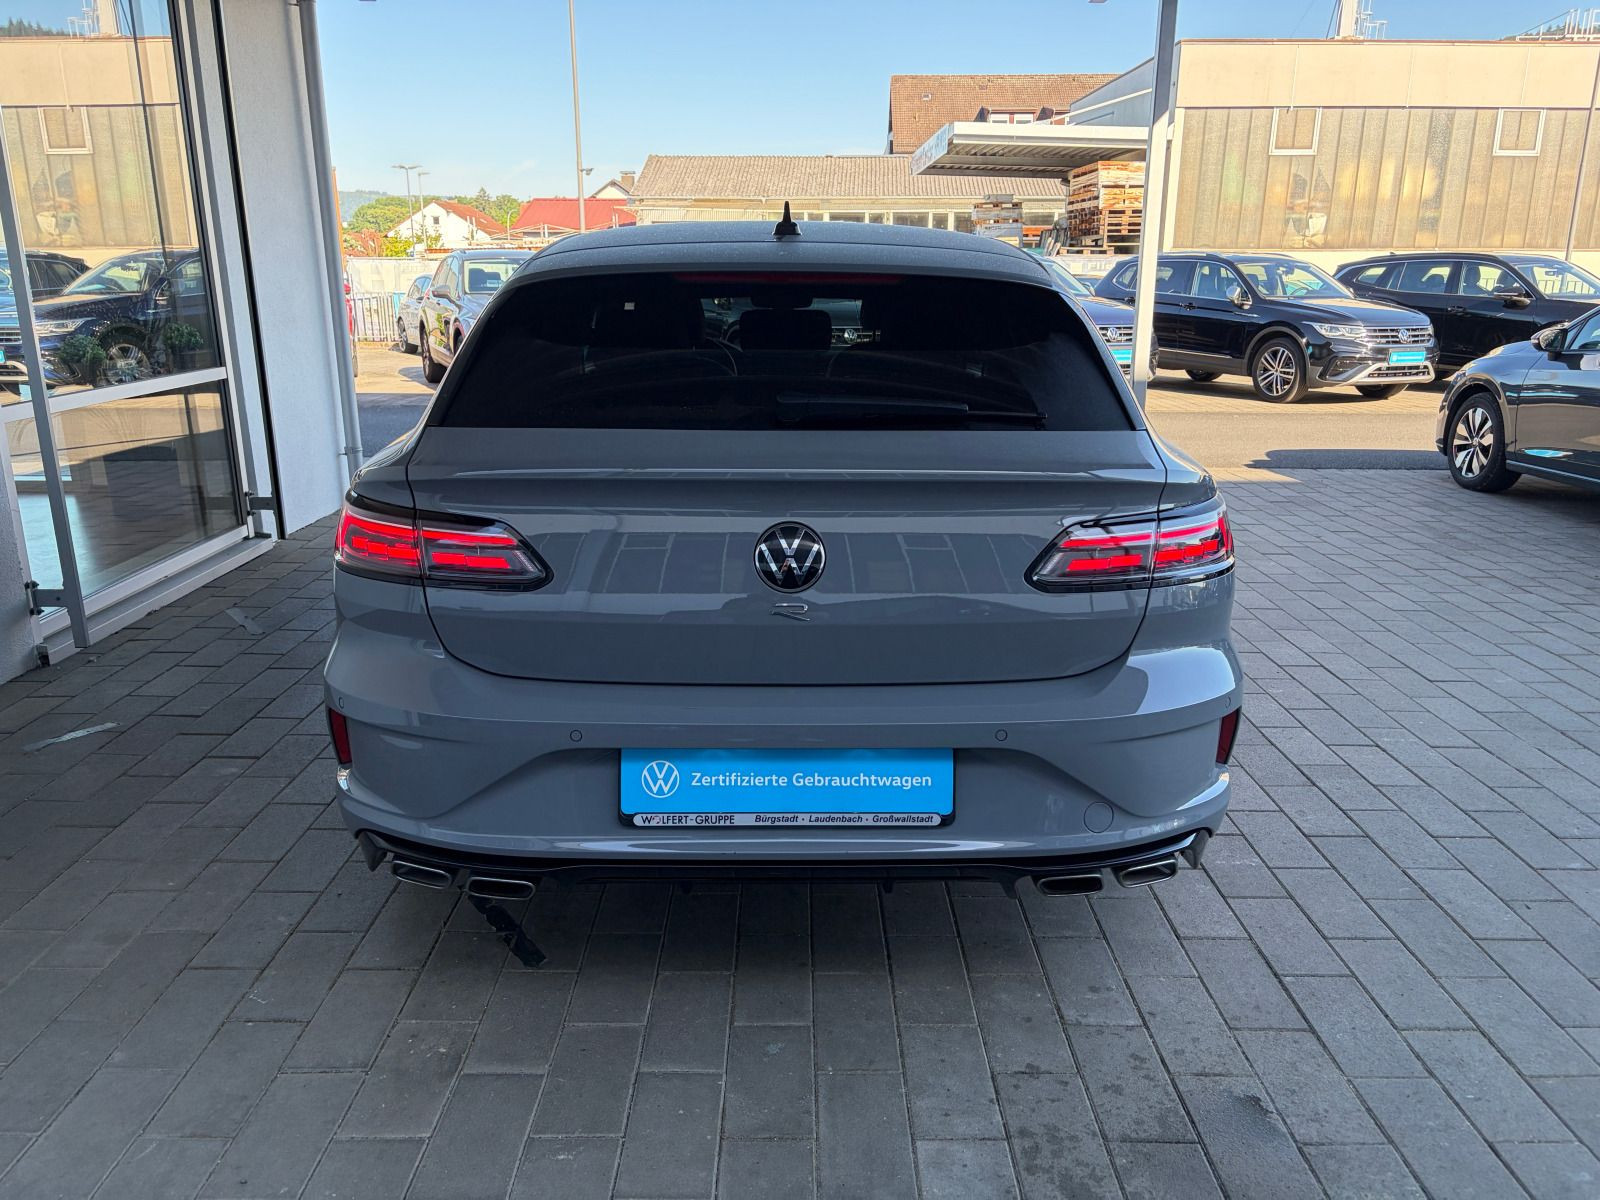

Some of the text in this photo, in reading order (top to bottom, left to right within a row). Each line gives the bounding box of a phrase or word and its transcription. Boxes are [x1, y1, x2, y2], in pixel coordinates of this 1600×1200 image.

[756, 523, 825, 592] VW
[642, 760, 680, 798] VW
[691, 772, 932, 790] Zertifizierte Gebrauchtwagen
[641, 815, 735, 825] WOLFERT-GRUPPE
[754, 814, 934, 824] Bürgstadt Laudenbach Großwallstadt
